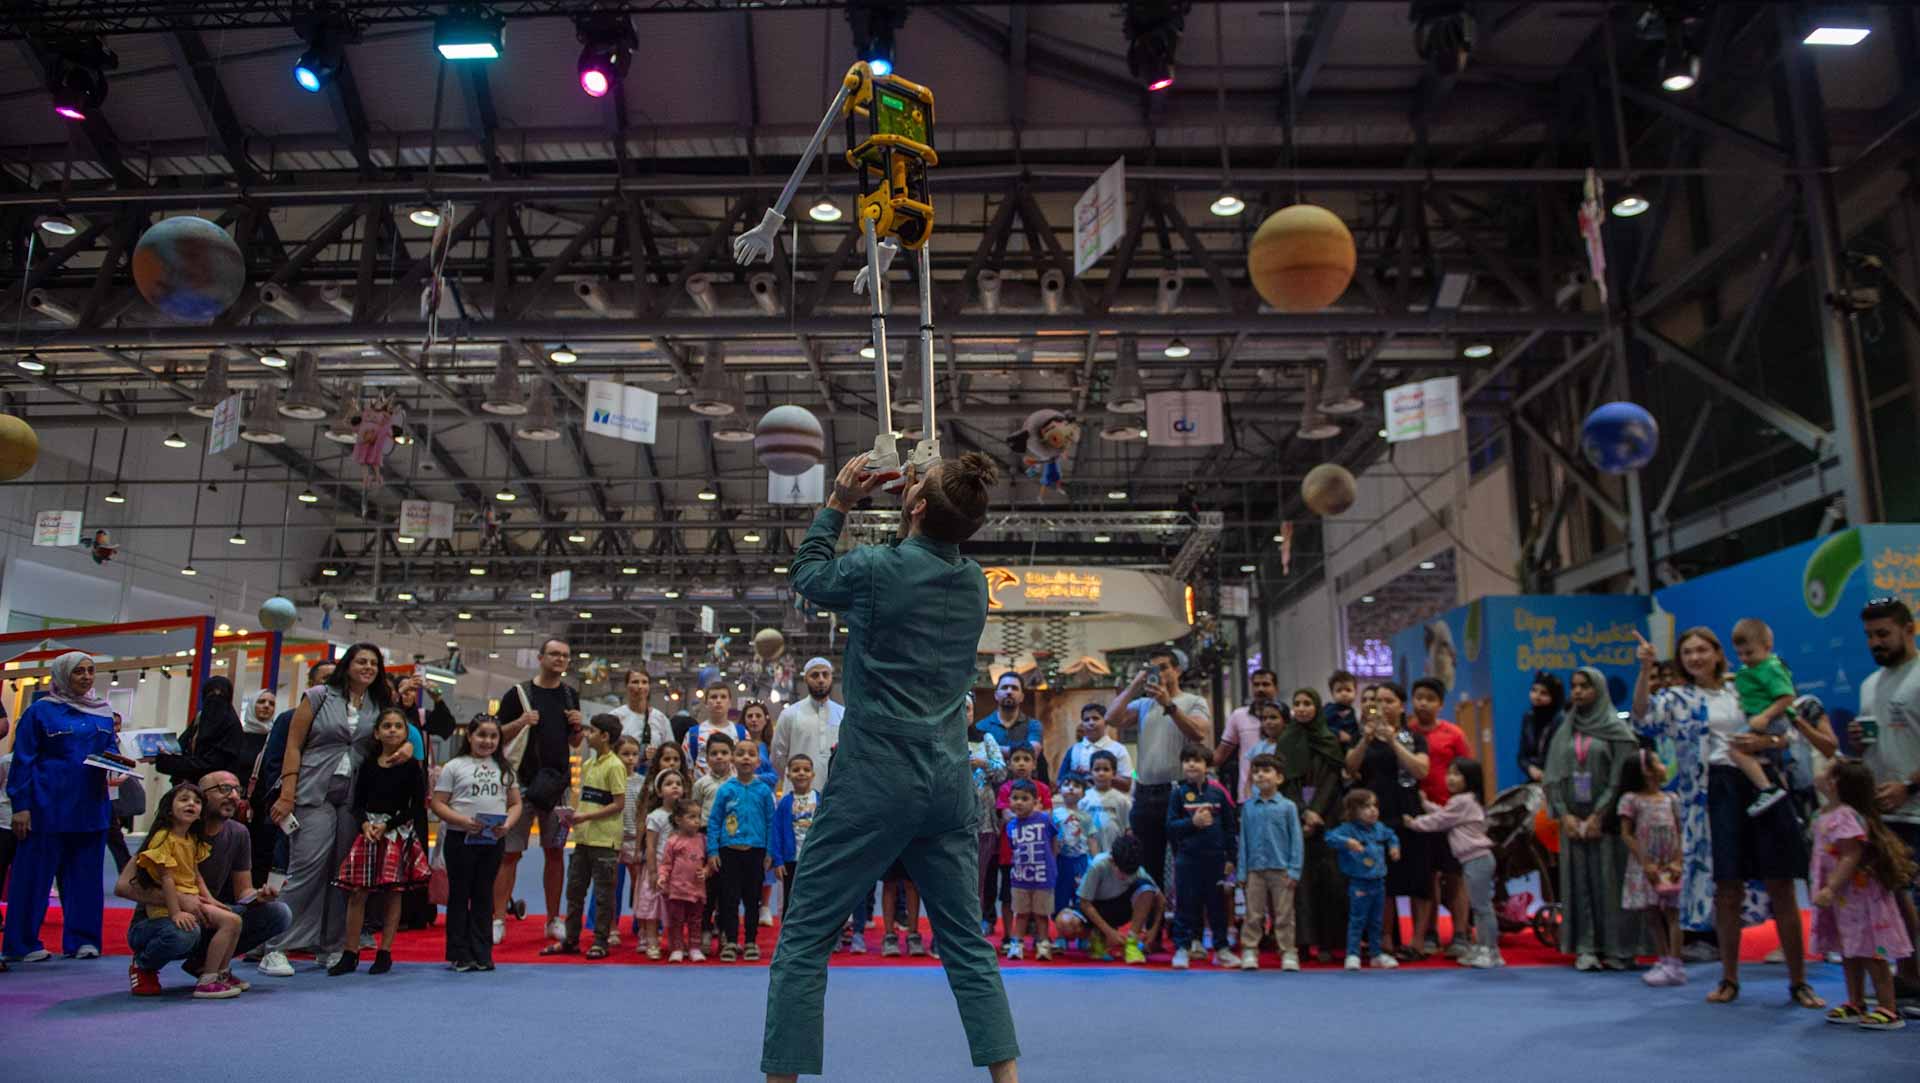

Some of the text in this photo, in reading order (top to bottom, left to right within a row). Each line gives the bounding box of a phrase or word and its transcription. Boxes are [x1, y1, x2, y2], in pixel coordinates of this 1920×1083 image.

[1518, 646, 1576, 671] Books
[471, 783, 498, 797] DAD
[1014, 842, 1046, 864] BE
[1010, 864, 1047, 882] NICE
